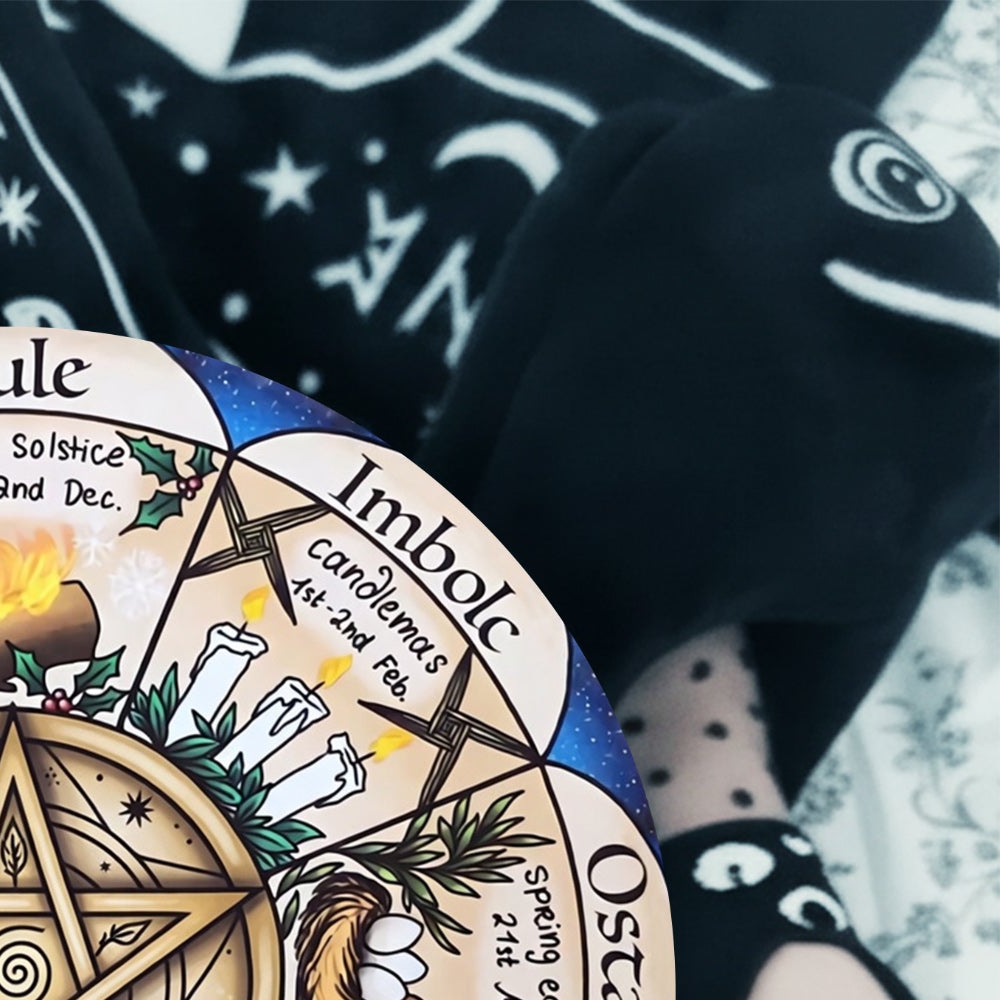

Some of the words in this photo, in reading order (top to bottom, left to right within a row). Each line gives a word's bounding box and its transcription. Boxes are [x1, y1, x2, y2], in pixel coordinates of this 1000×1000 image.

[64, 479, 122, 511] Dec.
[328, 453, 520, 653] Imbolc
[372, 655, 410, 702] Feb.
[492, 913, 520, 967] 21st
